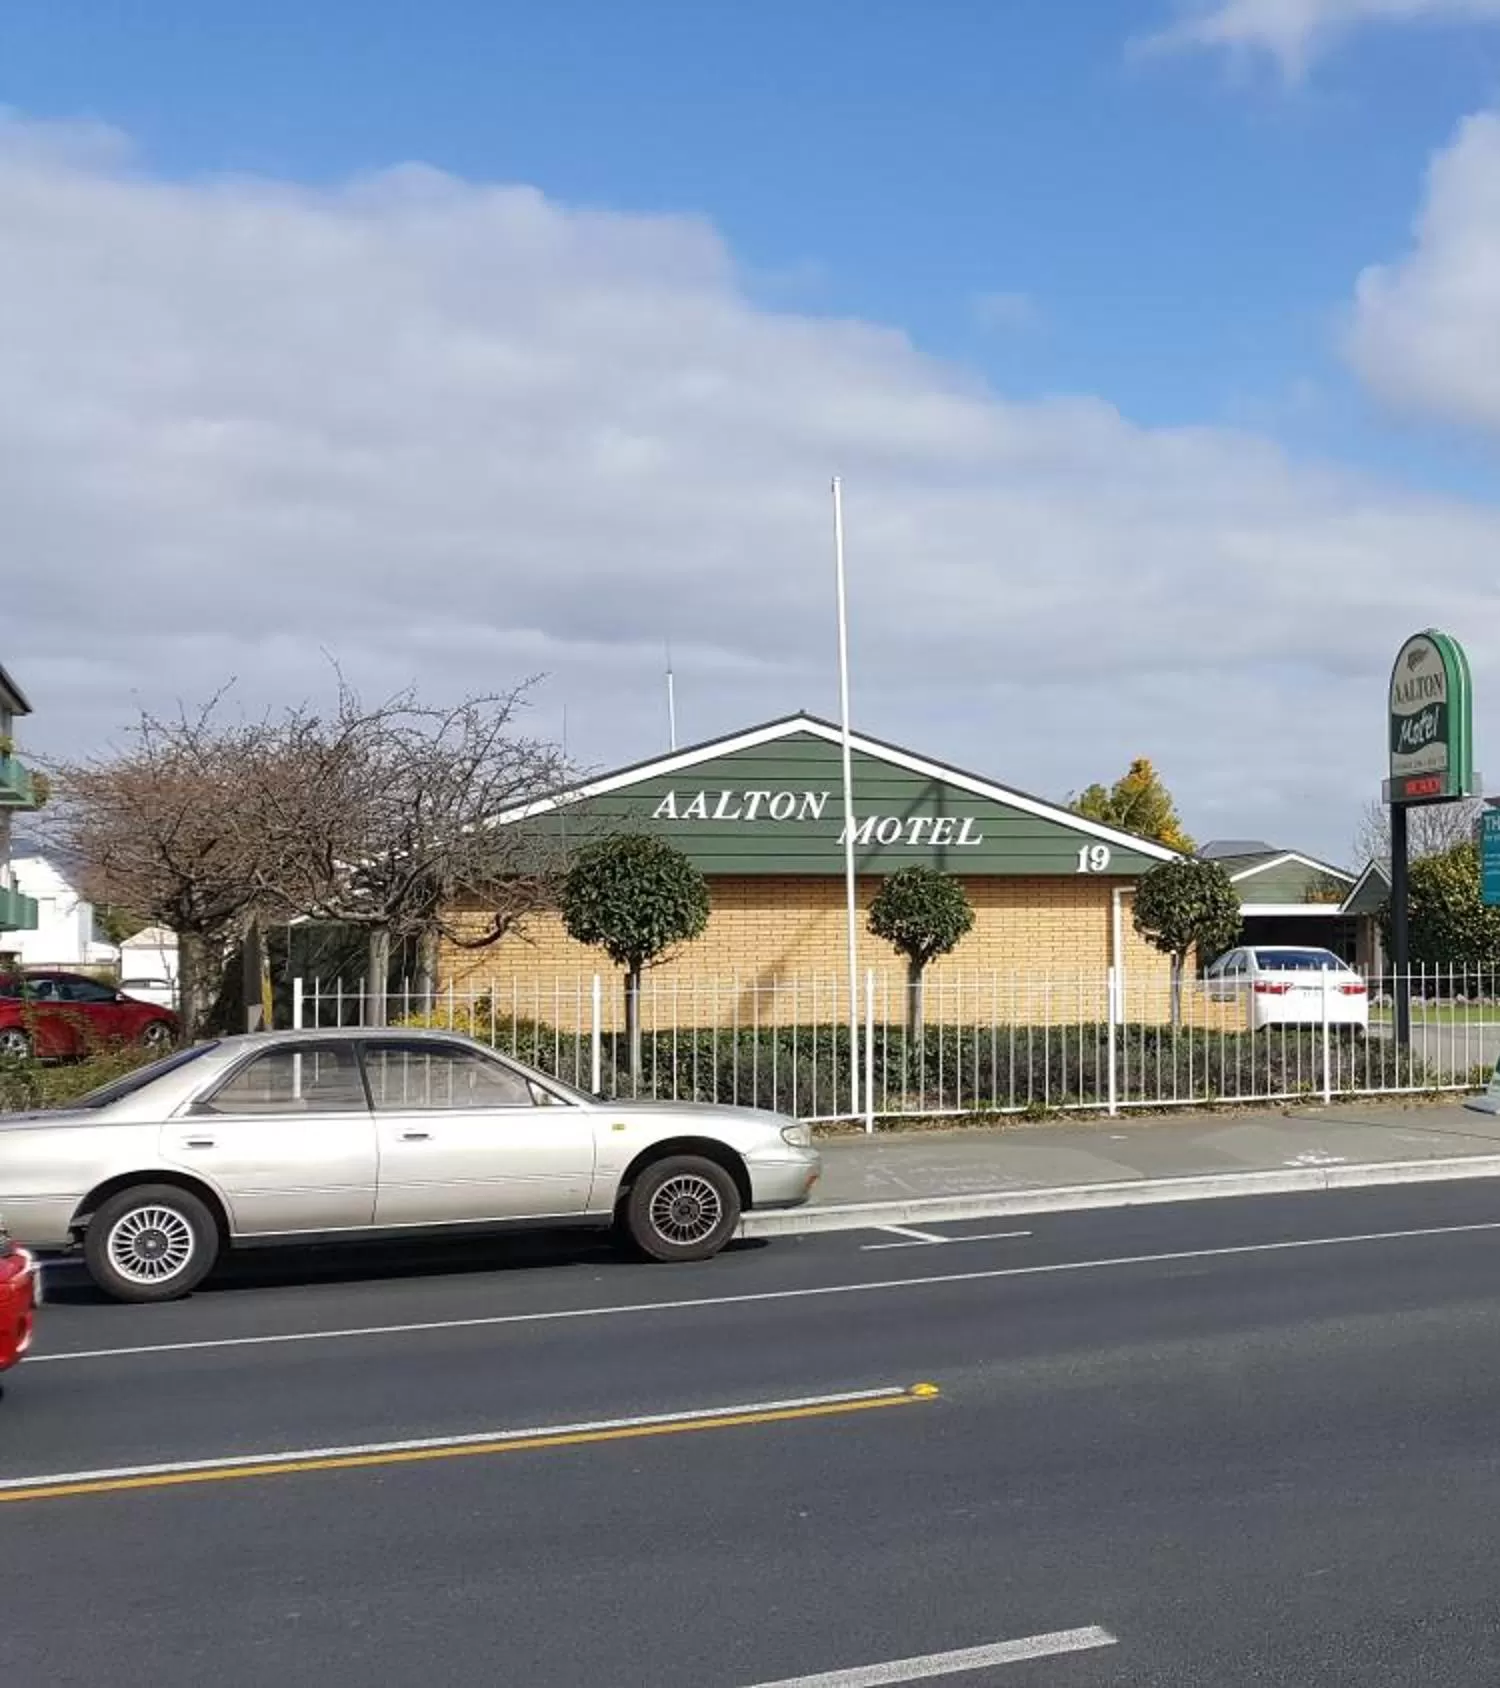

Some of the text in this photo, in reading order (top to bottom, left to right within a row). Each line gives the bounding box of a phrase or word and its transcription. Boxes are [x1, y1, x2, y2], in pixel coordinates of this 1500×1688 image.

[1394, 671, 1443, 705] AALTON
[1397, 704, 1440, 752] Motel
[652, 790, 830, 821] AALTON
[837, 815, 984, 845] MOTEL
[1076, 845, 1111, 874] 19
